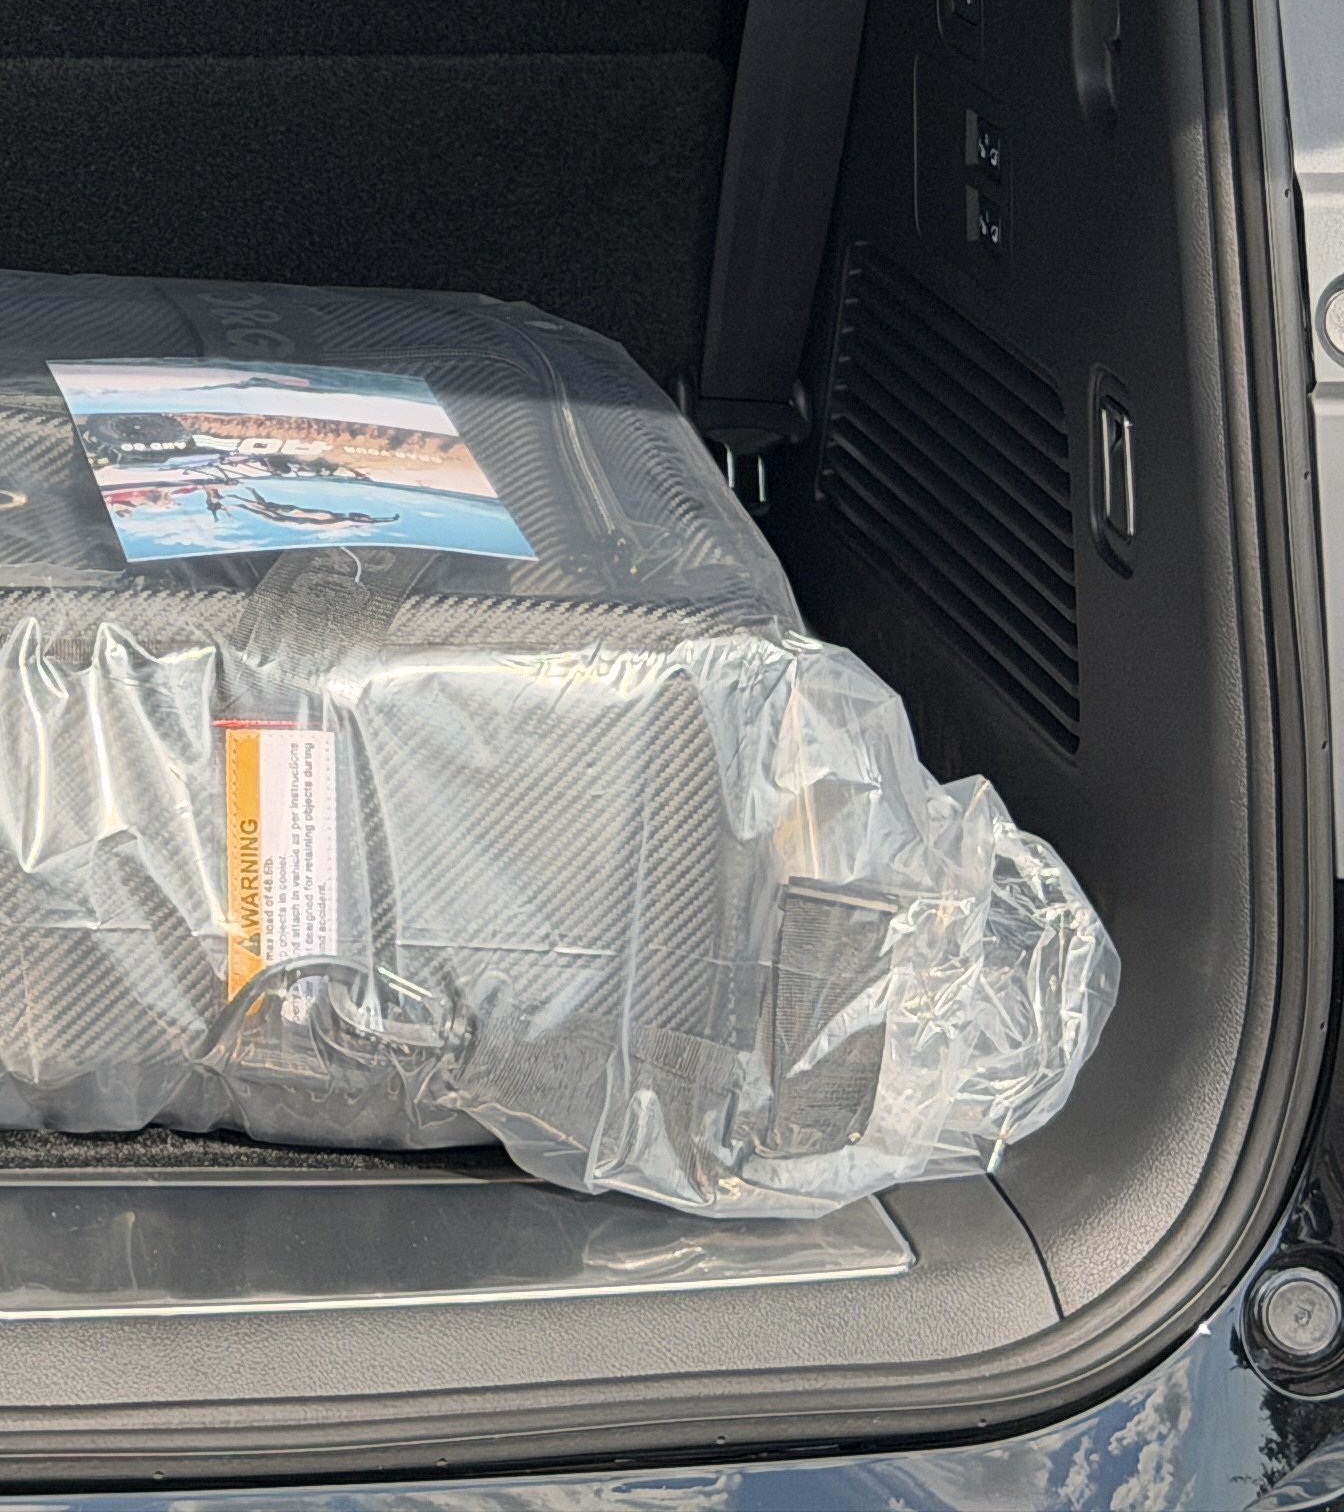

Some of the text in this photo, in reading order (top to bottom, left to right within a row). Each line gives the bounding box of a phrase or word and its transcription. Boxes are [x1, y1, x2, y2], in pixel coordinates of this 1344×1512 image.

[288, 742, 300, 809] instructions
[303, 742, 315, 778] during
[303, 780, 315, 822] objects
[291, 812, 302, 831] per
[292, 833, 301, 845] as
[303, 824, 315, 873] retaining
[240, 818, 260, 929] WARNING
[291, 848, 301, 888] vehicle
[304, 875, 314, 891] for
[263, 893, 274, 906] of
[291, 889, 301, 901] in
[263, 910, 274, 932] load
[304, 893, 315, 945] designed
